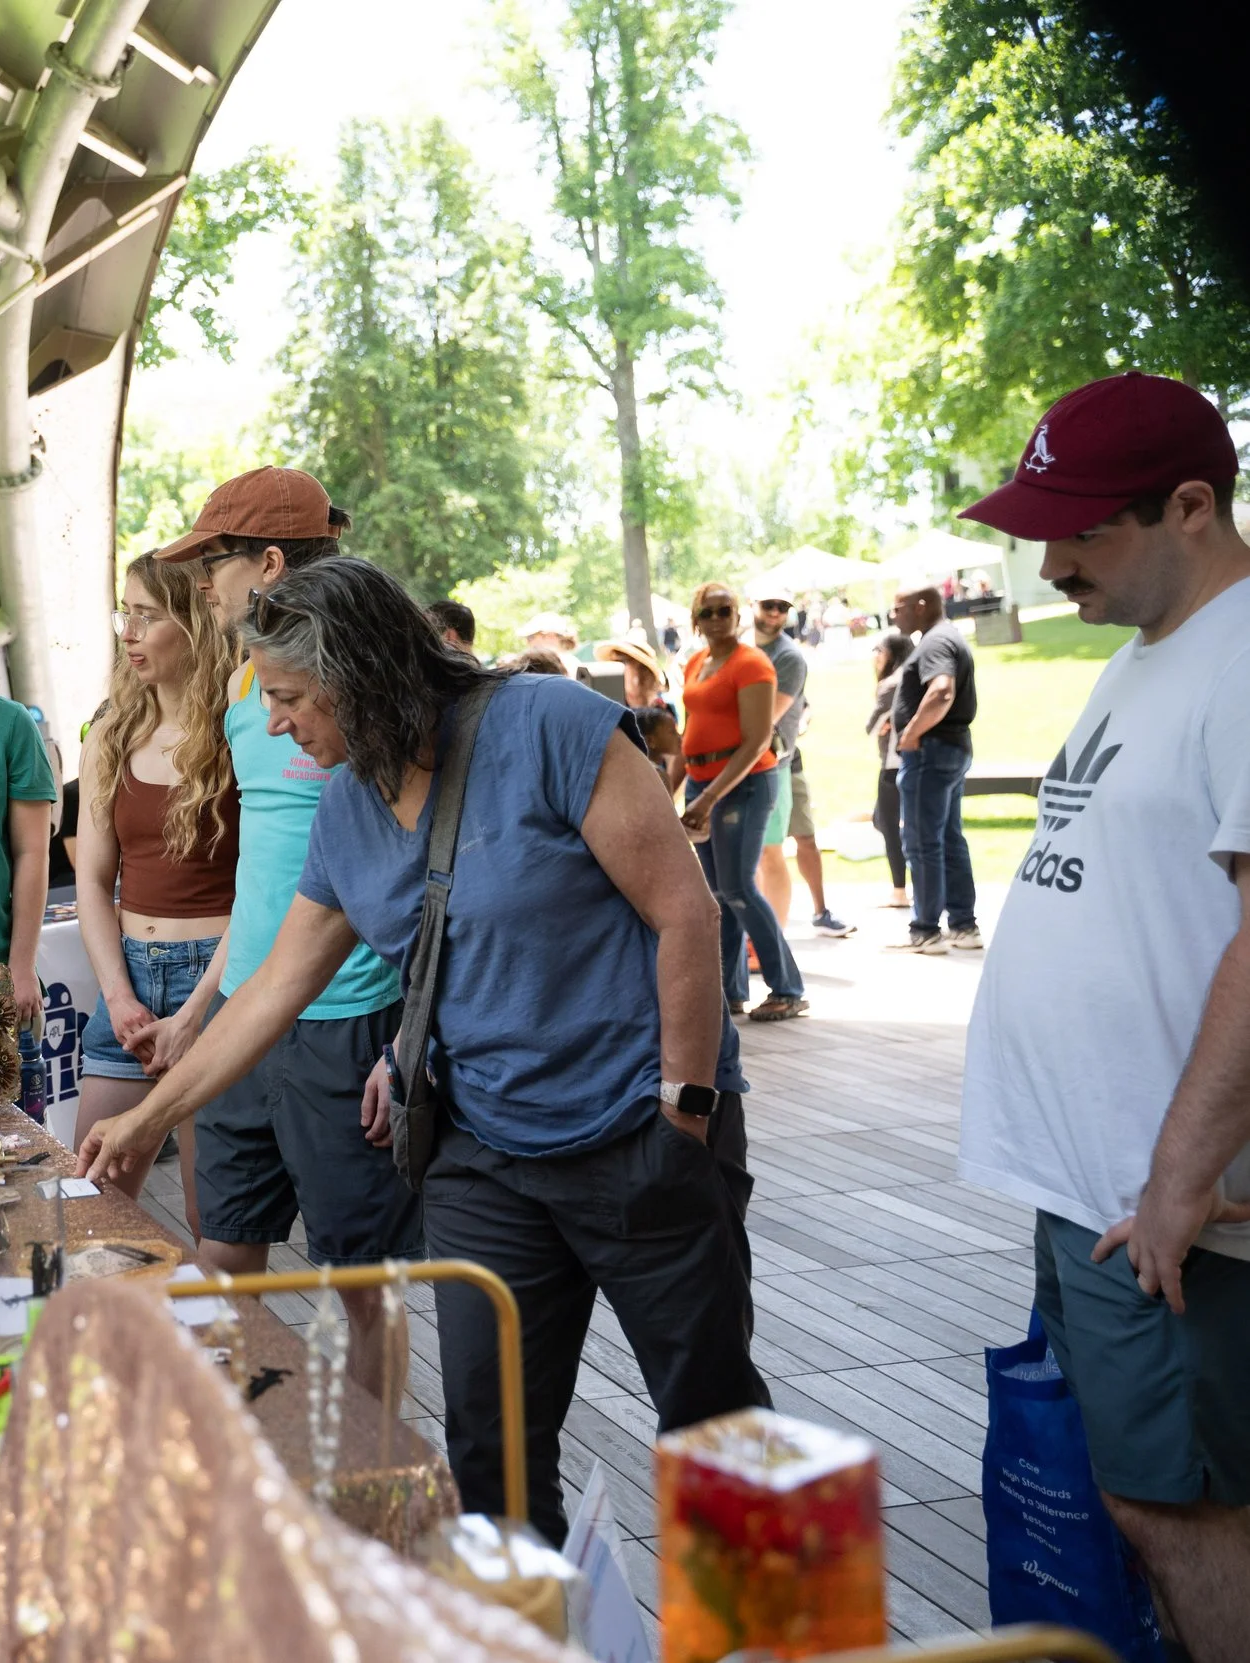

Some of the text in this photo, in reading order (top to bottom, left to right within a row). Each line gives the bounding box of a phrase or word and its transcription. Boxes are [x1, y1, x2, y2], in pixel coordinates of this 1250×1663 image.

[290, 757, 321, 770] SUMME
[49, 1024, 62, 1037] APL
[1018, 1458, 1040, 1475] Care
[1002, 1466, 1072, 1500] High Standards
[999, 1481, 1090, 1520] Making a Difference
[1022, 1511, 1056, 1535] Respect
[1021, 1560, 1079, 1597] Wegmans
